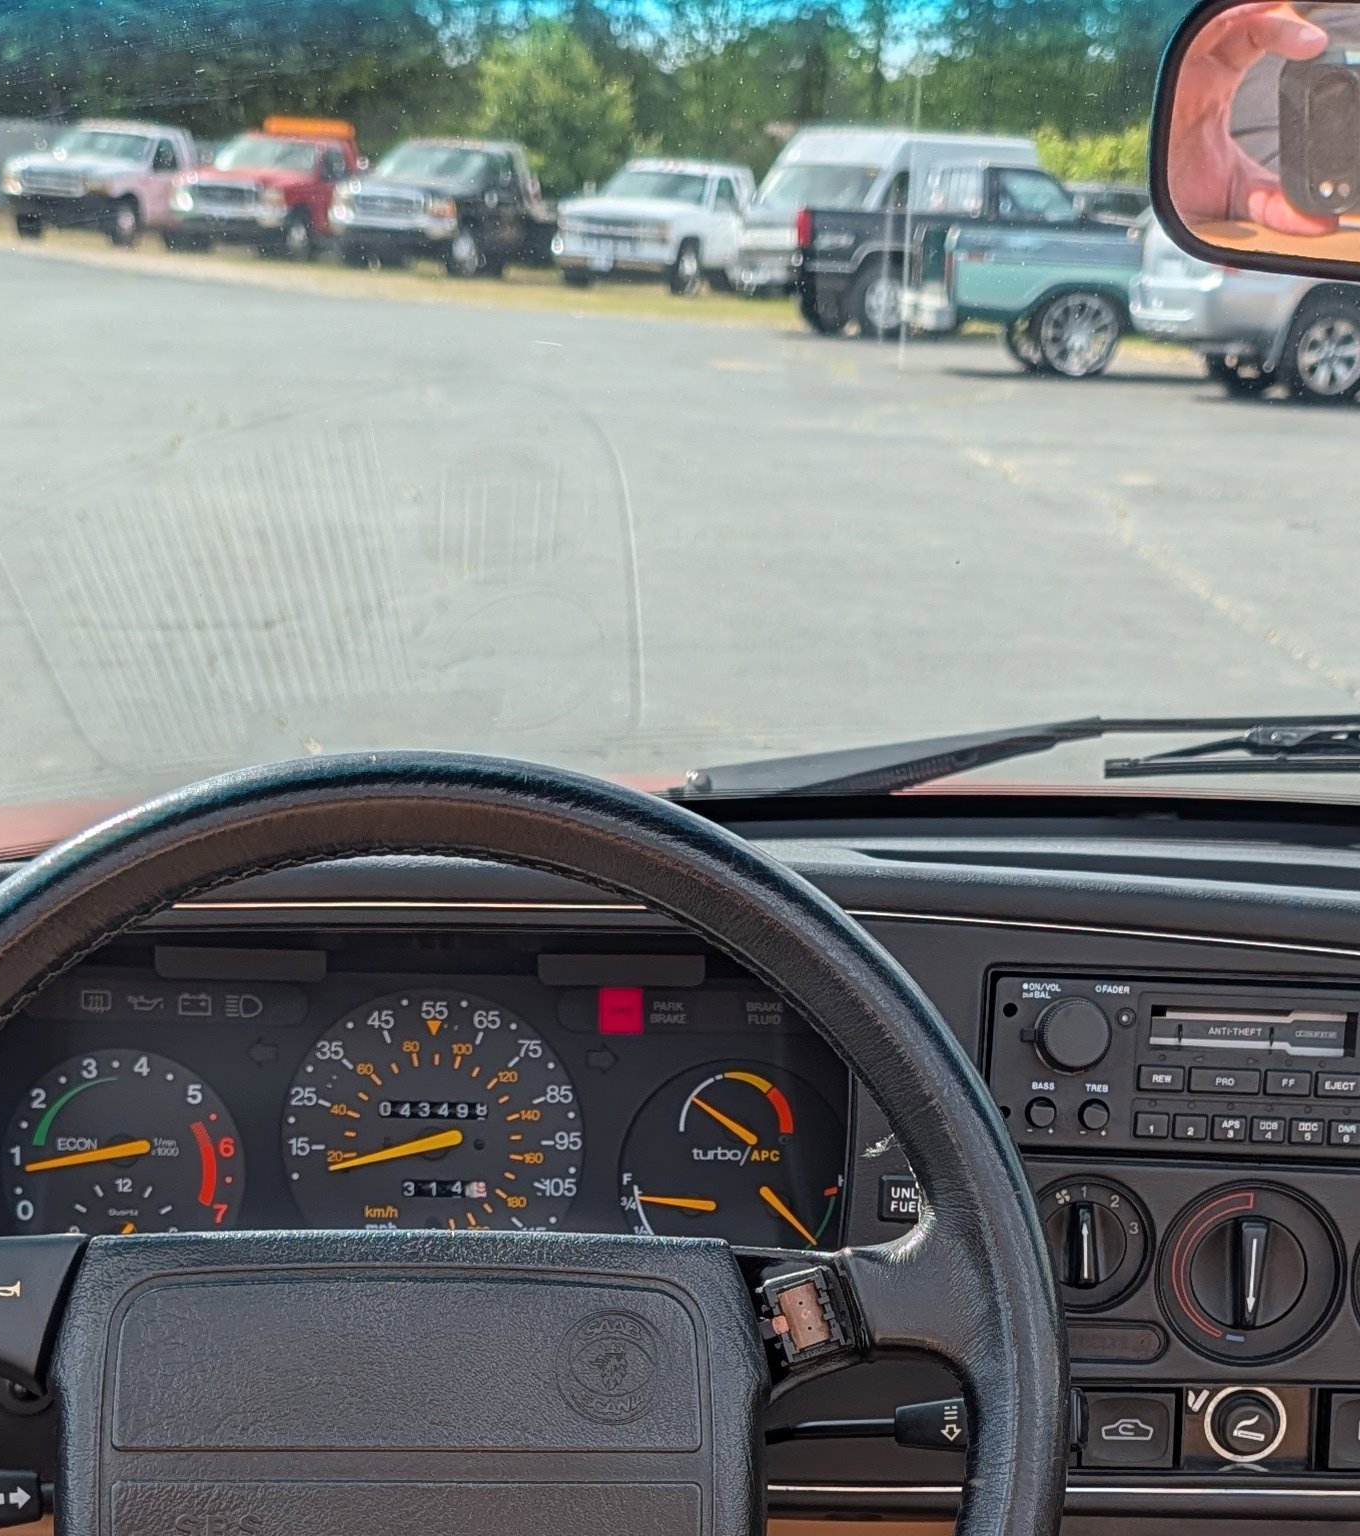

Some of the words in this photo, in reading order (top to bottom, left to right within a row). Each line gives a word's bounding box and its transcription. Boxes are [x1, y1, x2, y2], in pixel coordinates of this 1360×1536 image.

[1034, 991, 1051, 999] BAL
[421, 1001, 448, 1020] 55
[653, 1001, 684, 1011] PARK
[746, 1002, 784, 1012] BRAKE
[367, 1010, 395, 1029] 45
[473, 1010, 500, 1029] 65
[650, 1014, 686, 1024] BRAKE
[747, 1015, 782, 1025] FLUID
[1208, 1026, 1263, 1037] ANTI-THEFT
[315, 1041, 344, 1060] 35
[402, 1040, 420, 1052] 80
[451, 1043, 473, 1055] 100
[517, 1039, 542, 1058] 75
[81, 1058, 98, 1079] 3
[133, 1056, 150, 1076] 4
[356, 1063, 374, 1075] 60
[497, 1070, 518, 1083] 120
[1152, 1074, 1172, 1083] REW
[1215, 1077, 1235, 1086] PRO
[1281, 1078, 1296, 1088] FF
[1031, 1082, 1055, 1091] BASS
[1085, 1084, 1109, 1093] TREB
[1324, 1081, 1356, 1091] EJECT
[30, 1088, 47, 1109] 2
[186, 1084, 203, 1104] 5
[290, 1087, 317, 1107] 25
[546, 1085, 573, 1103] 85
[330, 1104, 347, 1115] 40
[519, 1109, 540, 1121] 140
[1222, 1120, 1240, 1129] APS
[57, 1138, 98, 1151] ECON
[218, 1136, 235, 1157] 6
[288, 1137, 310, 1156] 15
[554, 1131, 582, 1150] 95
[10, 1145, 21, 1166] 1
[327, 1151, 343, 1162] 20
[523, 1152, 544, 1164] 160
[622, 1172, 632, 1185] F
[115, 1178, 132, 1193] 12
[544, 1178, 577, 1197] 105
[1081, 1186, 1087, 1199] 1
[506, 1196, 527, 1208] 180
[620, 1196, 637, 1211] 3/4
[890, 1200, 917, 1213] FUE
[1110, 1195, 1120, 1208] 2
[16, 1200, 34, 1221] 0
[212, 1203, 228, 1223] 7
[364, 1204, 398, 1218] km/h
[1129, 1222, 1139, 1234] 3
